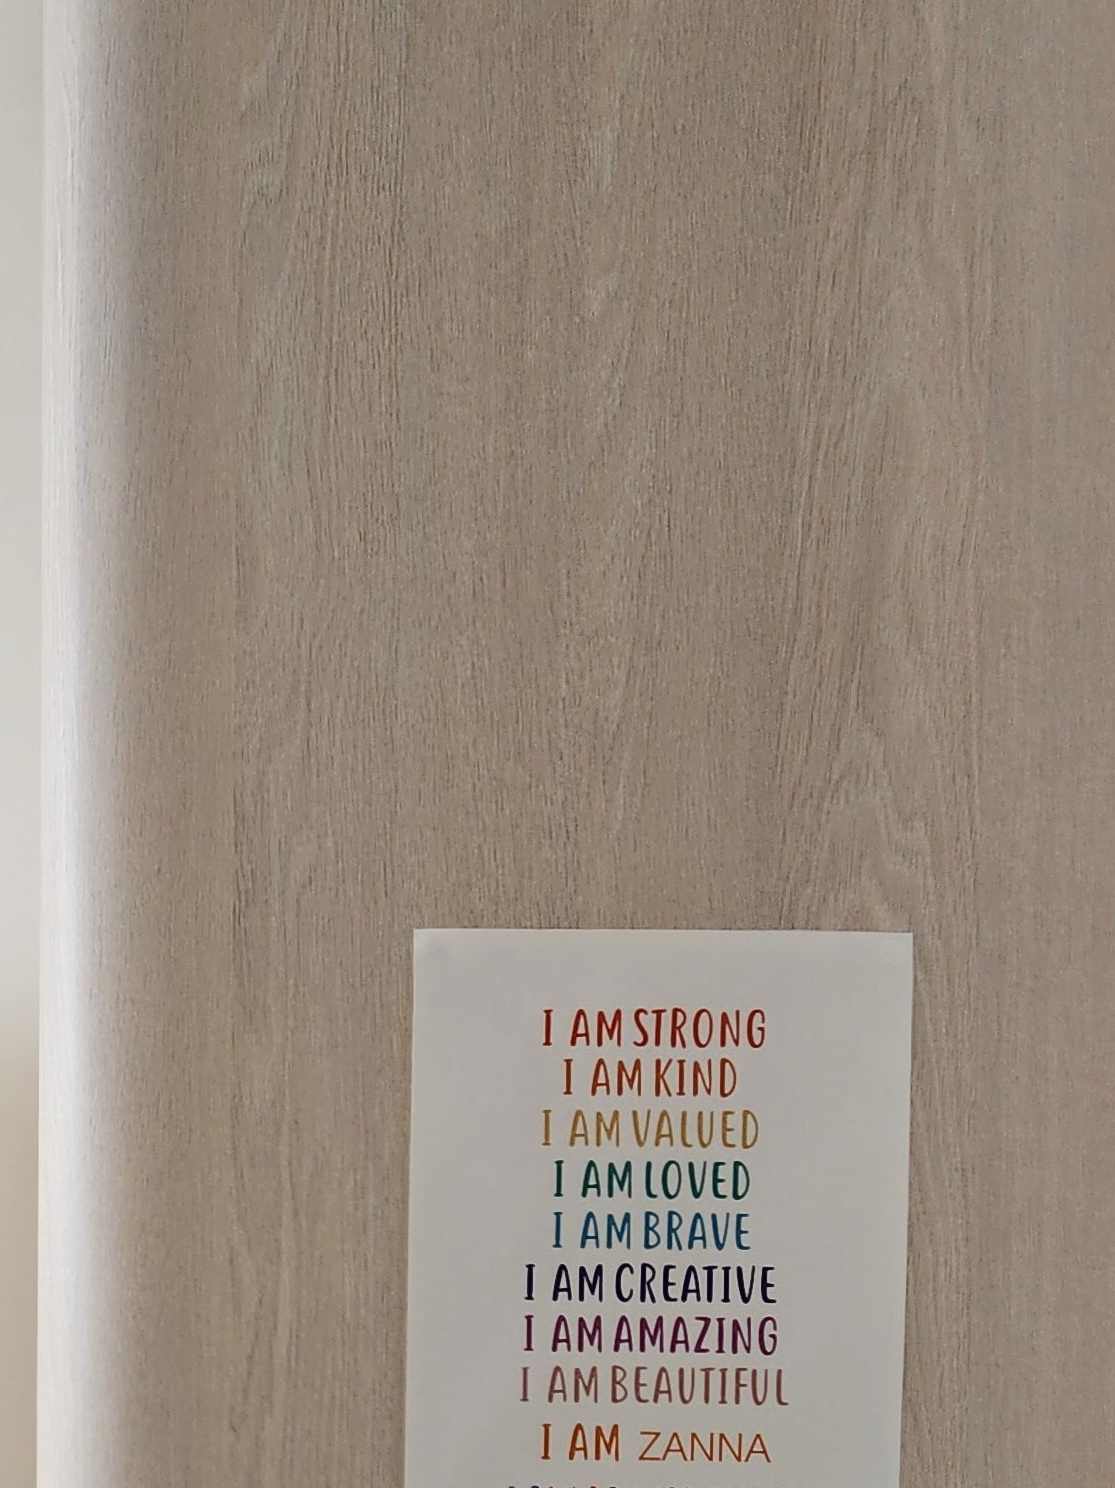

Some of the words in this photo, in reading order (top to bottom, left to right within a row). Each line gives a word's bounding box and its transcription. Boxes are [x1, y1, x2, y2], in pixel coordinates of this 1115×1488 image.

[541, 1008, 554, 1048] I
[569, 1007, 623, 1048] AM
[632, 1006, 766, 1050] STRONG
[562, 1058, 574, 1096] I
[590, 1057, 642, 1097] AM
[654, 1057, 737, 1099] KIND
[541, 1109, 552, 1147] I
[568, 1108, 620, 1148] AM
[631, 1108, 759, 1150] VALUED
[552, 1159, 565, 1198] I
[580, 1159, 633, 1199] AM
[644, 1159, 751, 1201] LOVED
[551, 1211, 564, 1249] I
[579, 1210, 632, 1251] AM
[643, 1209, 752, 1252] BRAVE
[523, 1263, 536, 1301] I
[551, 1263, 604, 1303] AM
[614, 1262, 778, 1305] CREATIVE
[523, 1314, 535, 1352] I
[550, 1314, 603, 1354] AM
[612, 1314, 778, 1357] AMAZING
[519, 1366, 530, 1403] I
[547, 1365, 599, 1404] AM
[610, 1364, 789, 1407] BEAUTIFUL
[540, 1422, 552, 1461] I
[568, 1422, 620, 1463] AM
[637, 1430, 772, 1464] ZANNA
